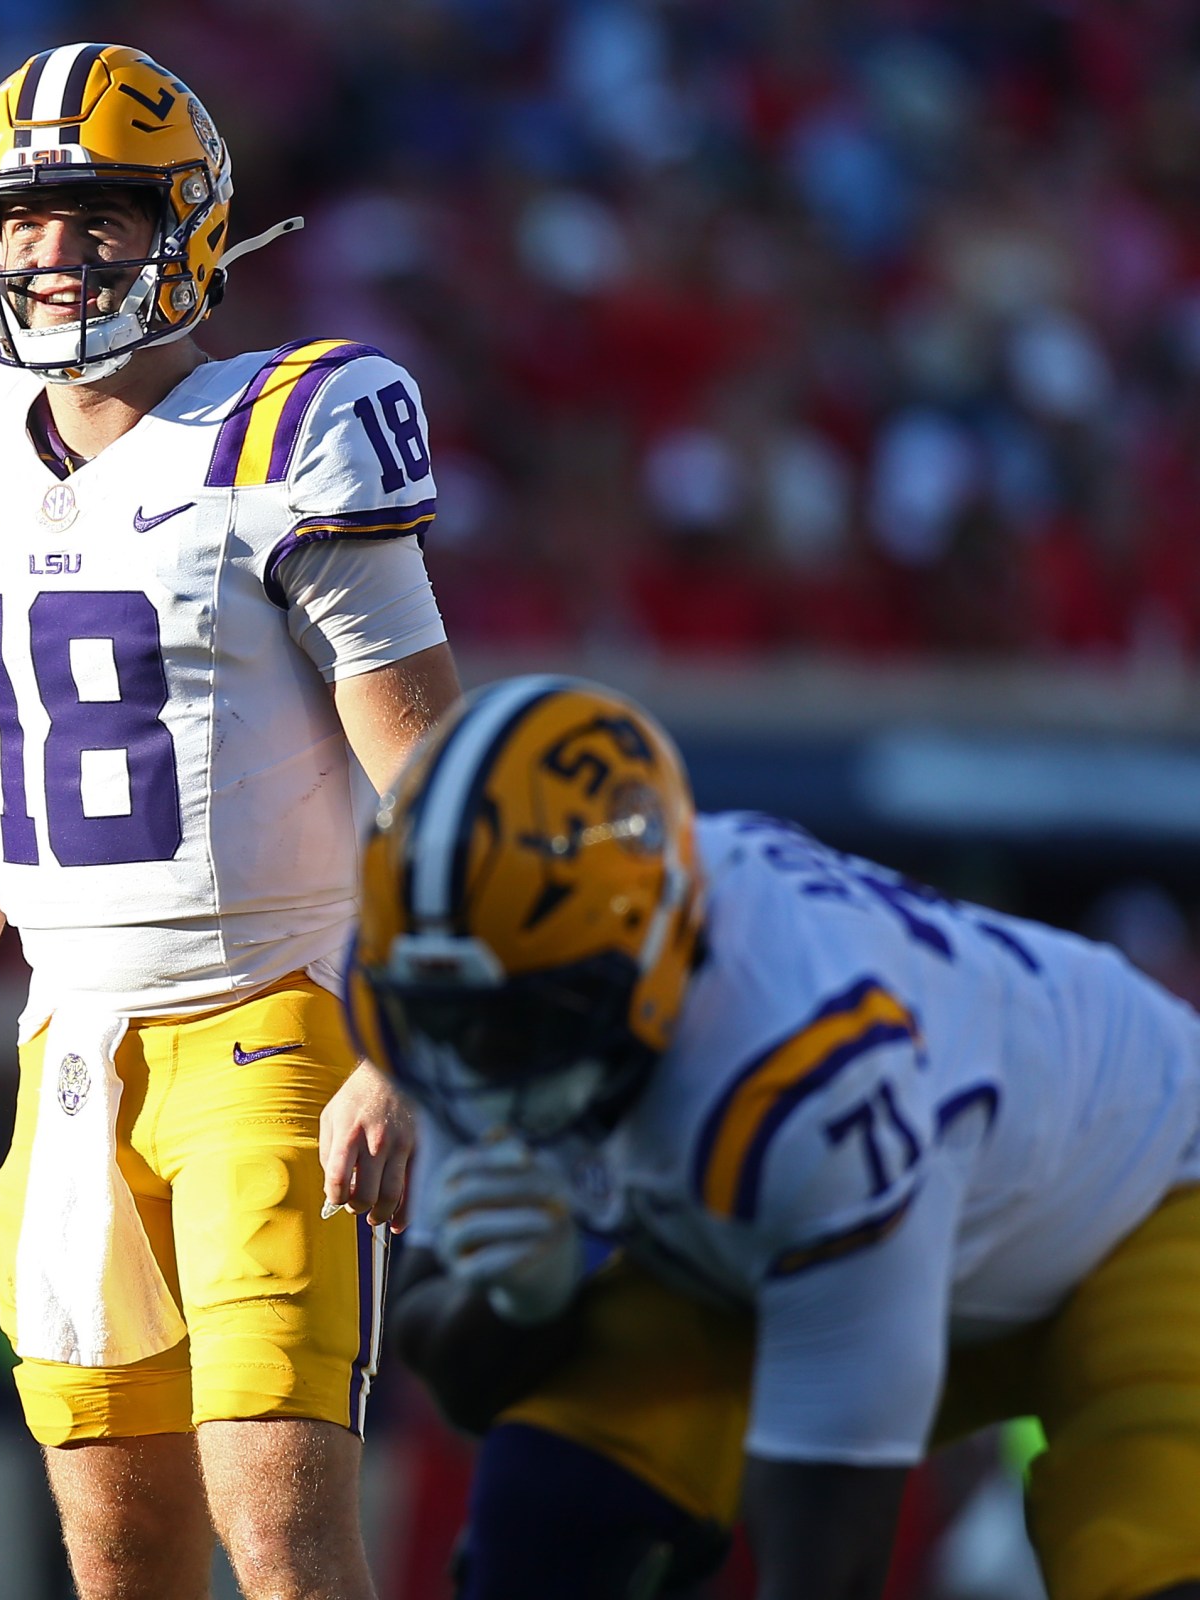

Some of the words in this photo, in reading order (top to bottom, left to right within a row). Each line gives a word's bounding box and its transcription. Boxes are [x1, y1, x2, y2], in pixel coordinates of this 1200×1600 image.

[18, 149, 73, 167] LSU
[353, 380, 430, 494] 18
[28, 553, 82, 575] LSU
[824, 1080, 922, 1199] 71
